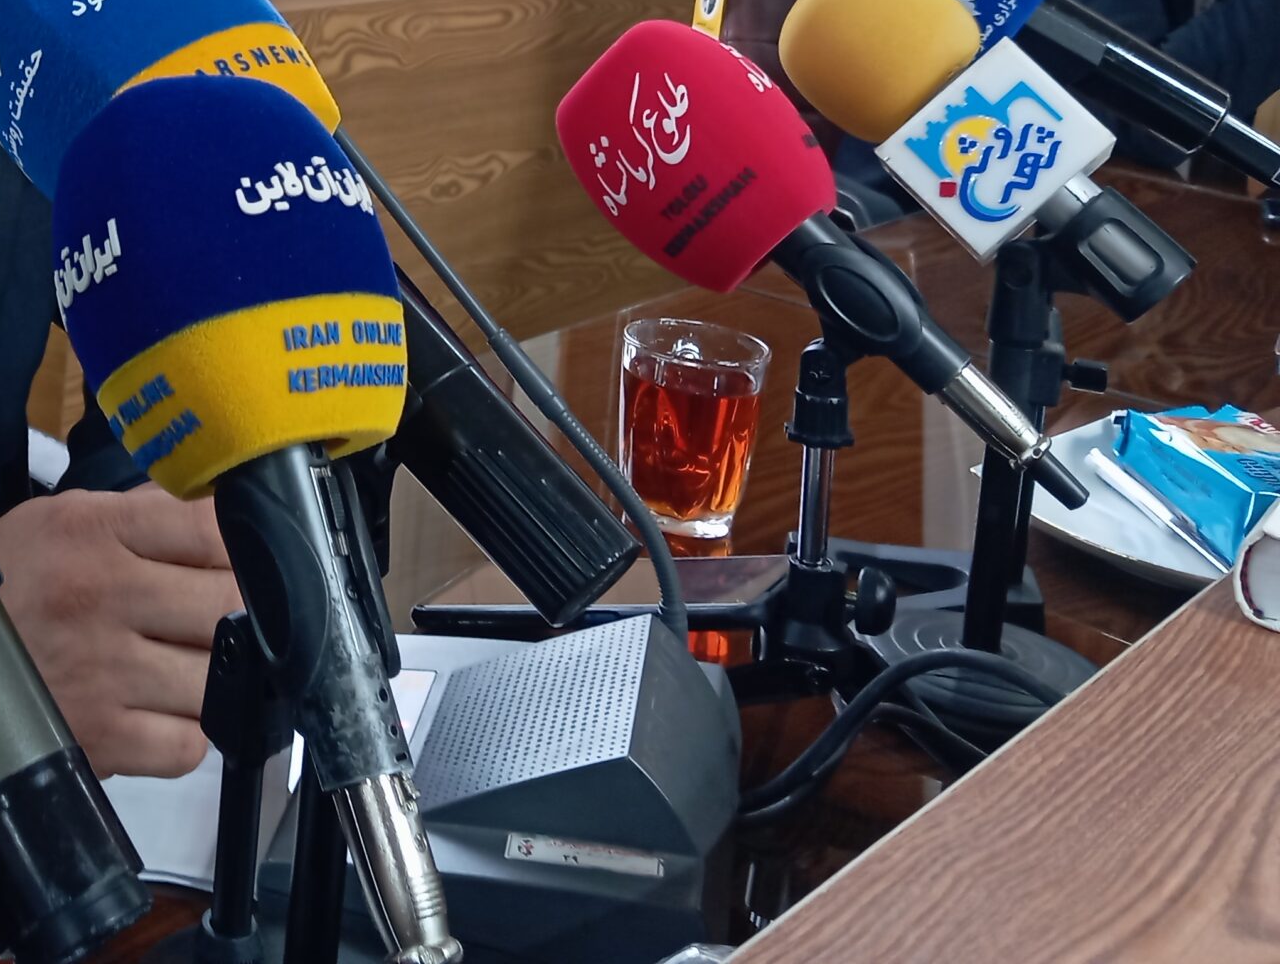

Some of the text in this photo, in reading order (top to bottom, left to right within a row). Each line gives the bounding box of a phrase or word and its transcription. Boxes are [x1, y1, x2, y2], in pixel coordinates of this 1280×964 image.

[9, 49, 43, 121] حقیقت
[195, 45, 311, 77] RSNEW
[589, 72, 691, 217] طلوع کرمانشاه
[72, 217, 122, 294] ایران
[283, 319, 402, 352] IRAN ONLINE
